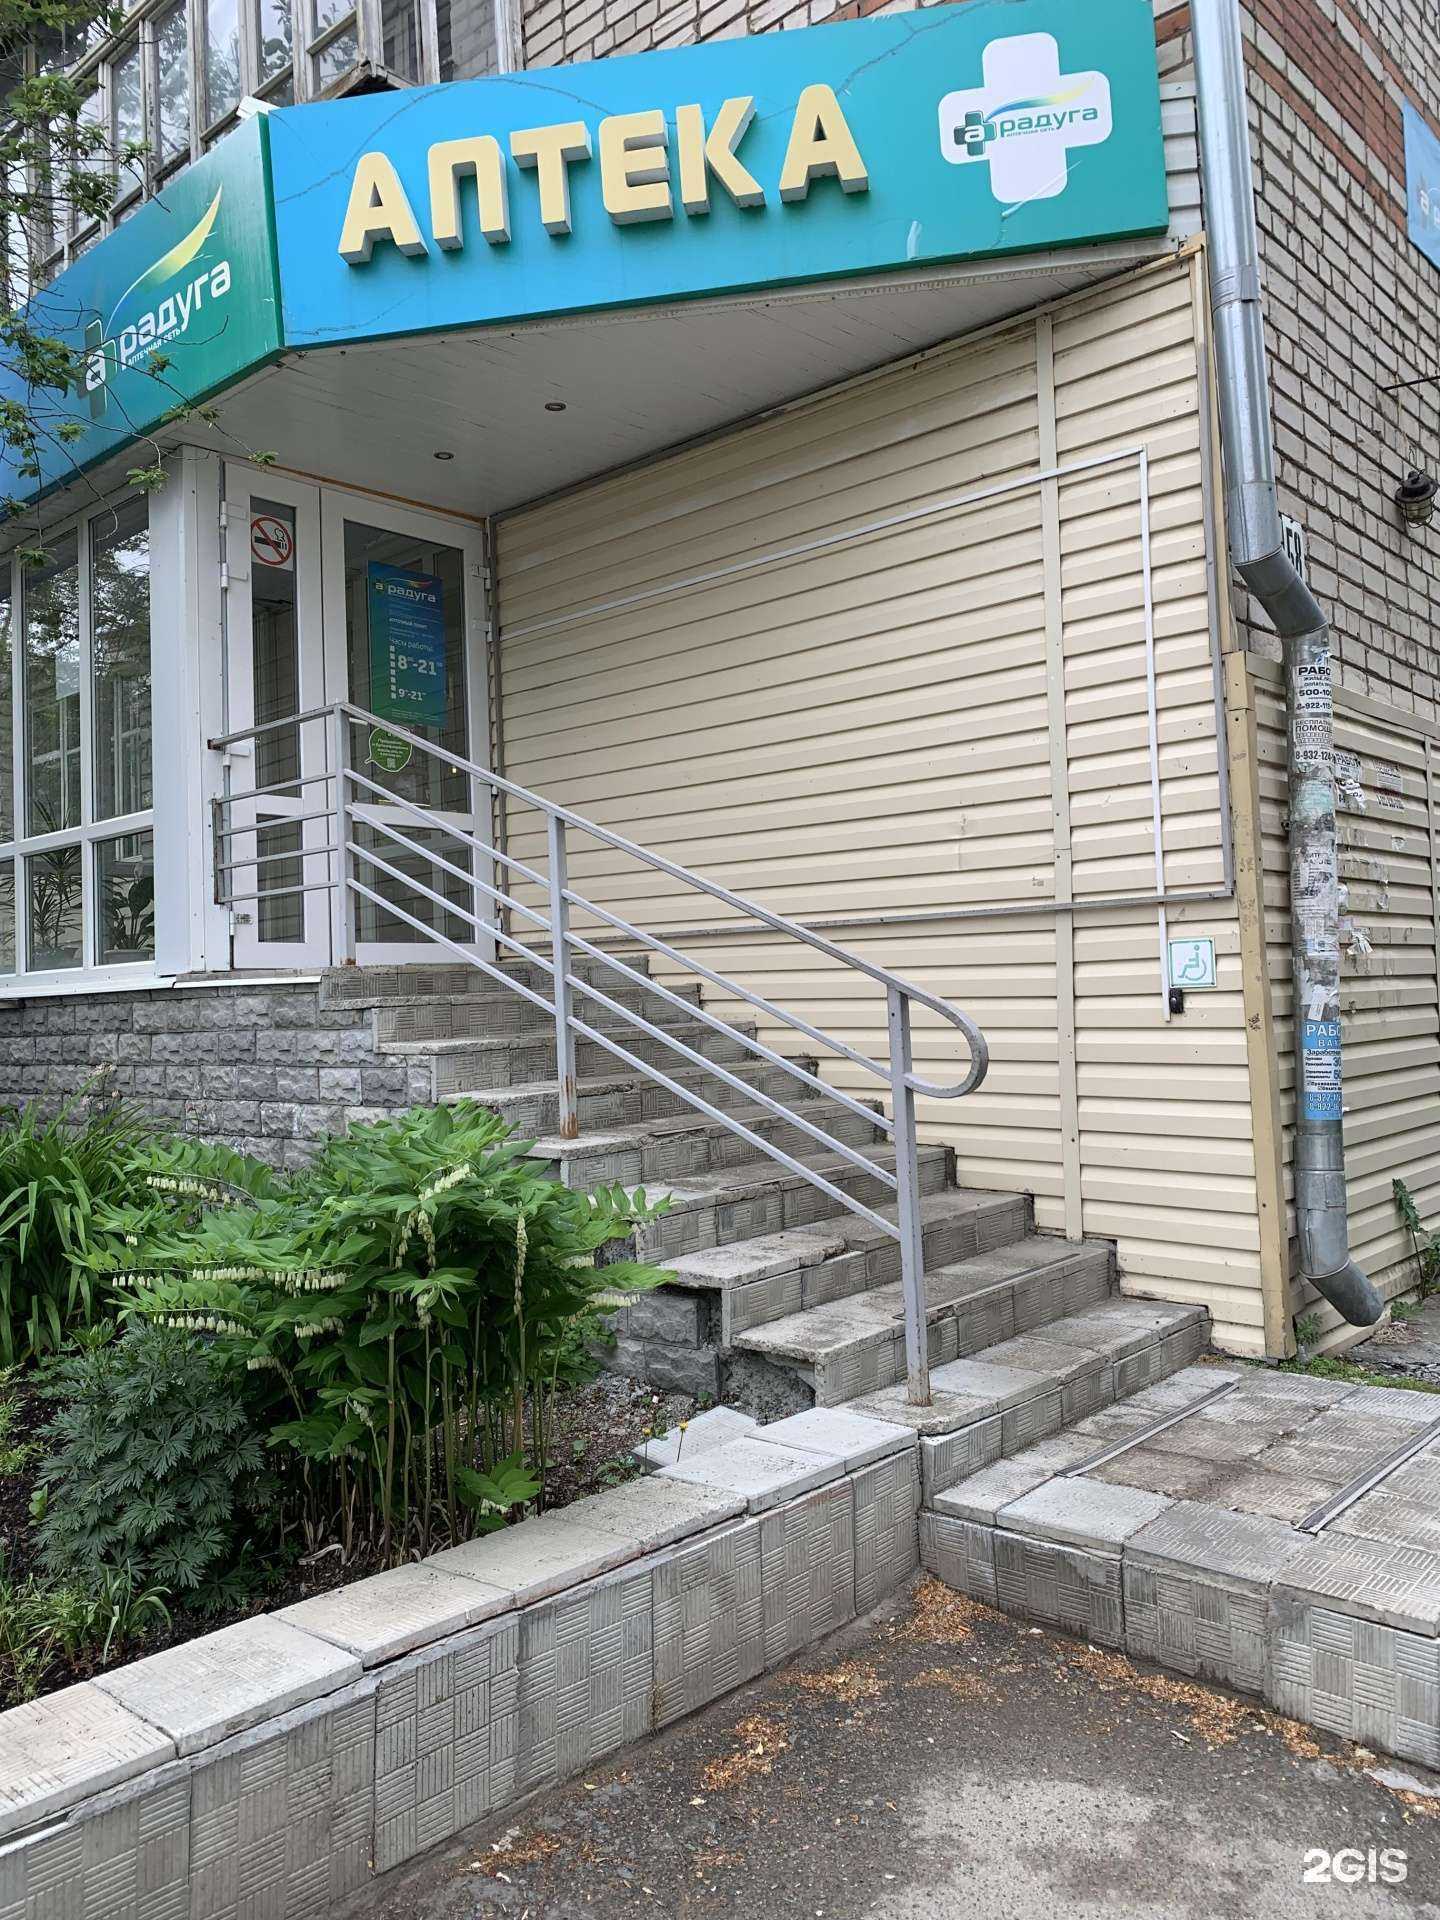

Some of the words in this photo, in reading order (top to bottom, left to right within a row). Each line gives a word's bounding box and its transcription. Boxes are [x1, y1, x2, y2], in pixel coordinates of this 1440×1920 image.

[1000, 107, 1098, 137] радуга
[338, 84, 869, 264] АПТЕКА
[119, 260, 231, 370] радуга
[388, 585, 436, 602] радуга
